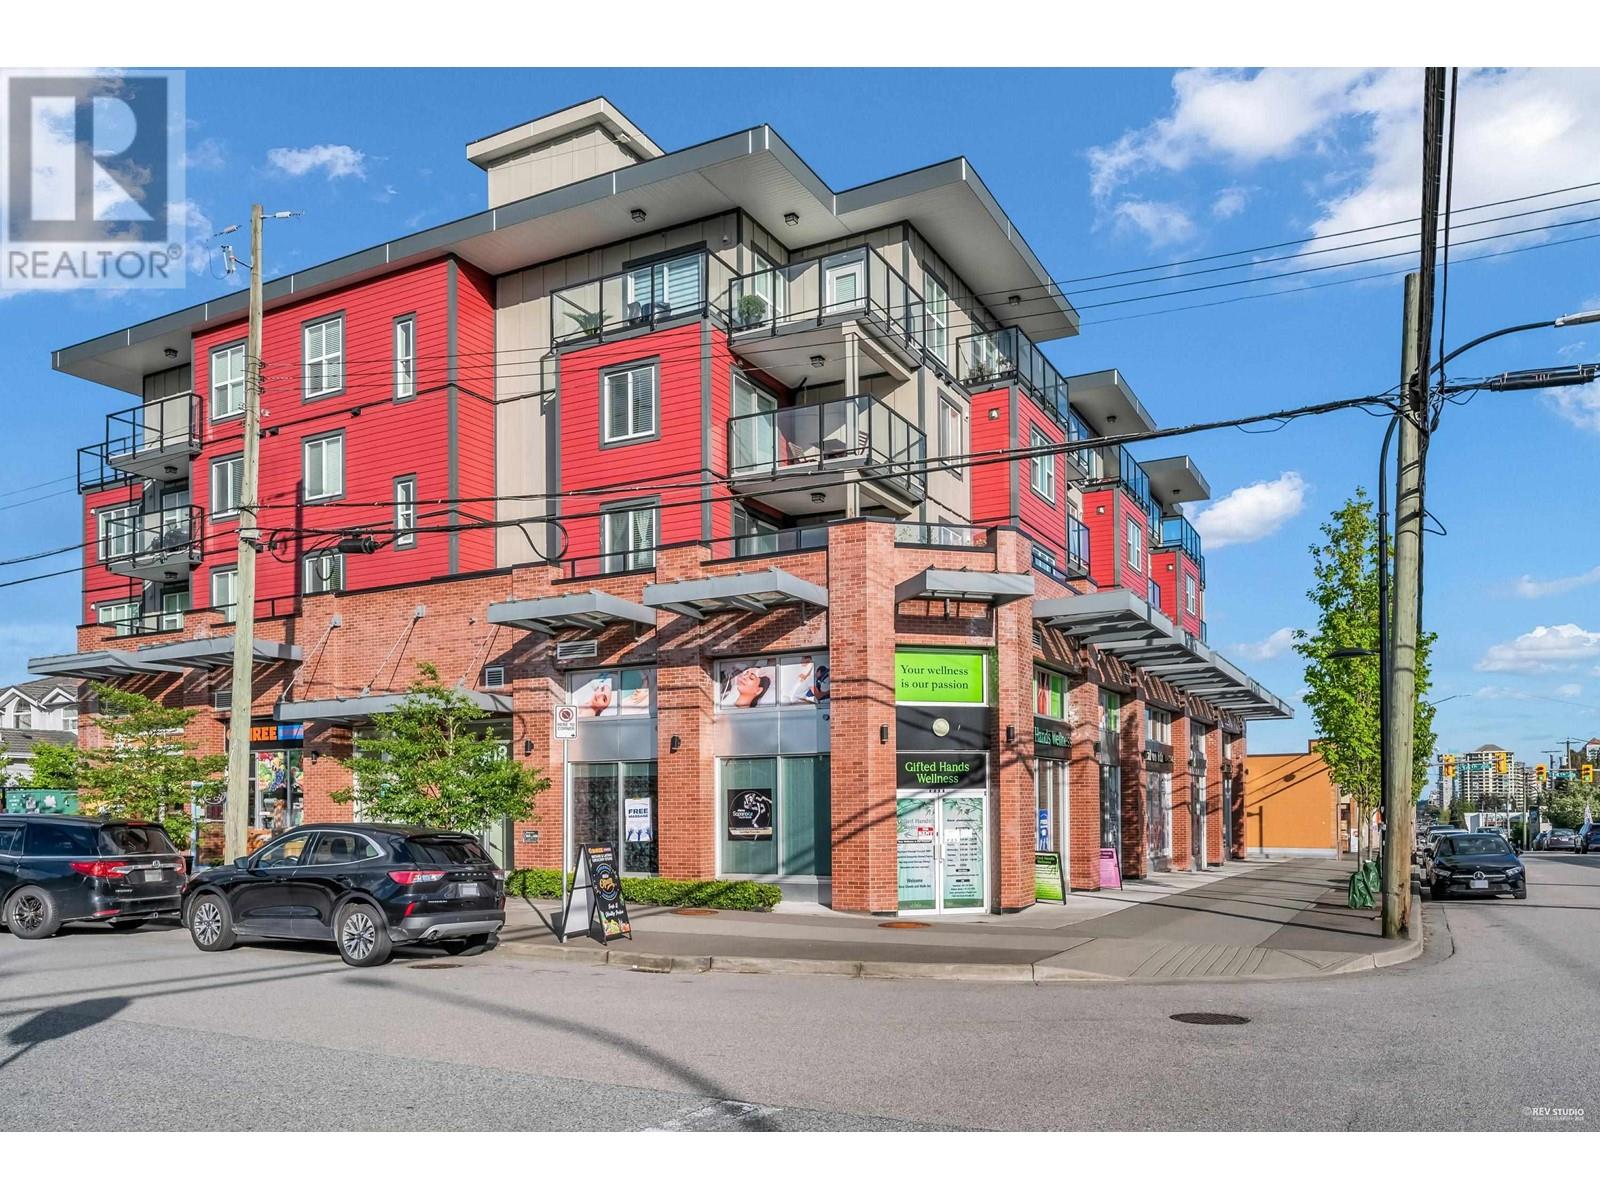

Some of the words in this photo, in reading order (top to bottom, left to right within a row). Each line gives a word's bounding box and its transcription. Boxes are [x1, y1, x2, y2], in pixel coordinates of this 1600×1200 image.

[900, 664, 925, 675] Your
[927, 666, 969, 676] wellness
[901, 679, 910, 689] is
[931, 680, 969, 692] passion
[905, 761, 936, 772] Gifted
[939, 761, 970, 772] Hands
[917, 773, 959, 784] Wellness
